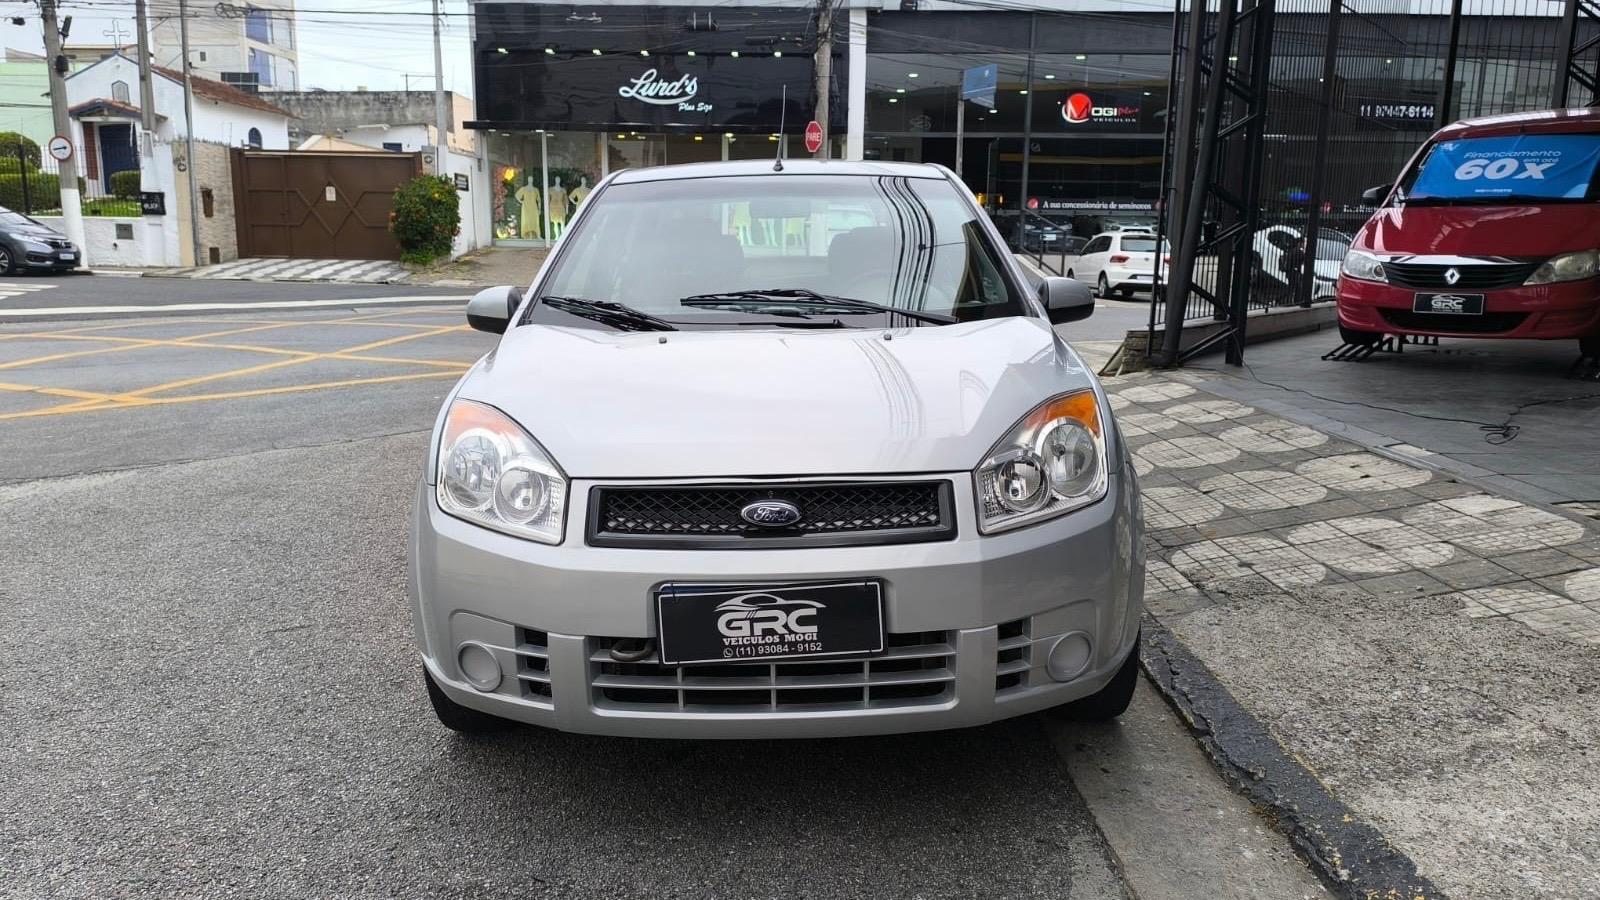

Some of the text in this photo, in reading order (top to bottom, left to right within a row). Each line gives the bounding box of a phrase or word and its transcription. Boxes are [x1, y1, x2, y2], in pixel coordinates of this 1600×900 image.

[619, 69, 698, 105] Lurd's
[679, 103, 695, 111] Plus
[807, 132, 821, 142] PARE
[1464, 150, 1562, 159] Financiamento
[1042, 201, 1049, 209] A
[1109, 201, 1117, 209] de
[1432, 299, 1463, 309] GRC
[754, 506, 789, 520] Ford
[717, 607, 818, 637] GRC
[723, 632, 818, 646] VEICULOS MOGI
[736, 647, 756, 657] (11)
[758, 644, 789, 654] 93084
[797, 642, 822, 652] 9152
